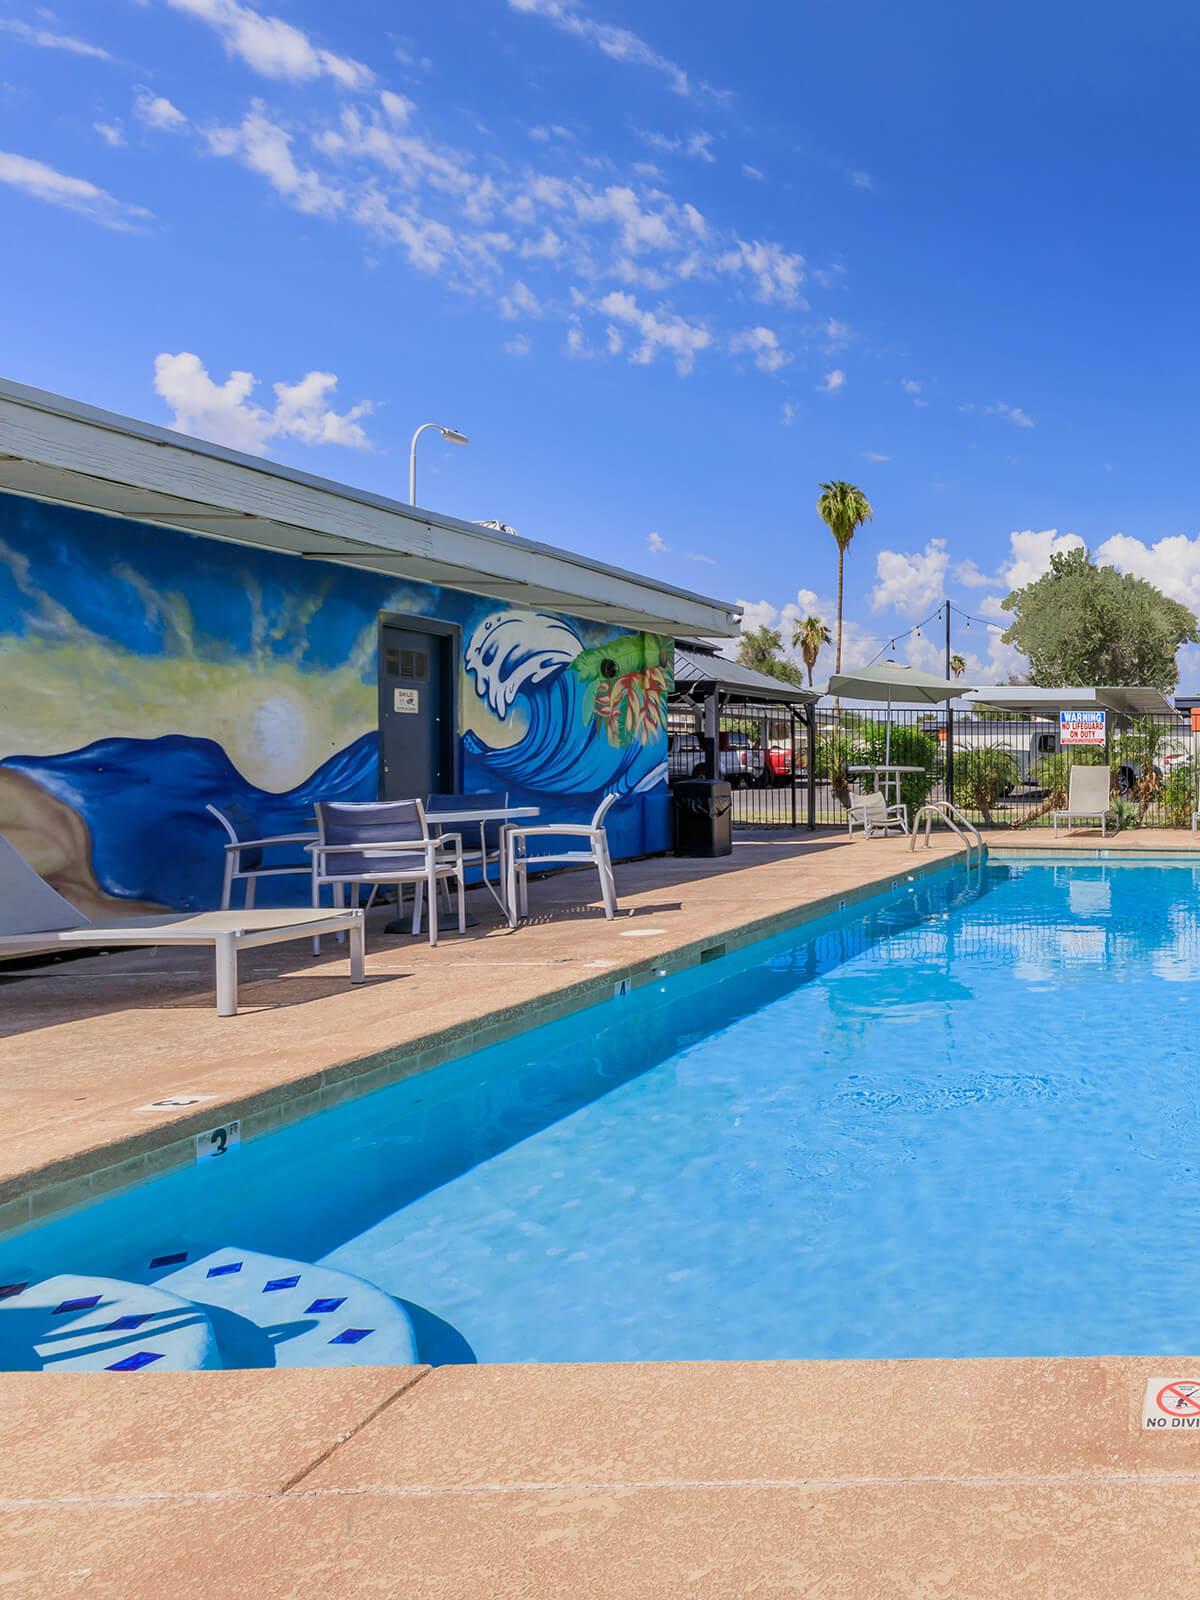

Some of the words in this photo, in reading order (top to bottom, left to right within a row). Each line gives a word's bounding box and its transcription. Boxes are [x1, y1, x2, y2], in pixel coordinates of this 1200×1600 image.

[1065, 712, 1102, 722] WARNING
[1072, 722, 1103, 730] LIFEGUARD
[1147, 1418, 1167, 1427] NO
